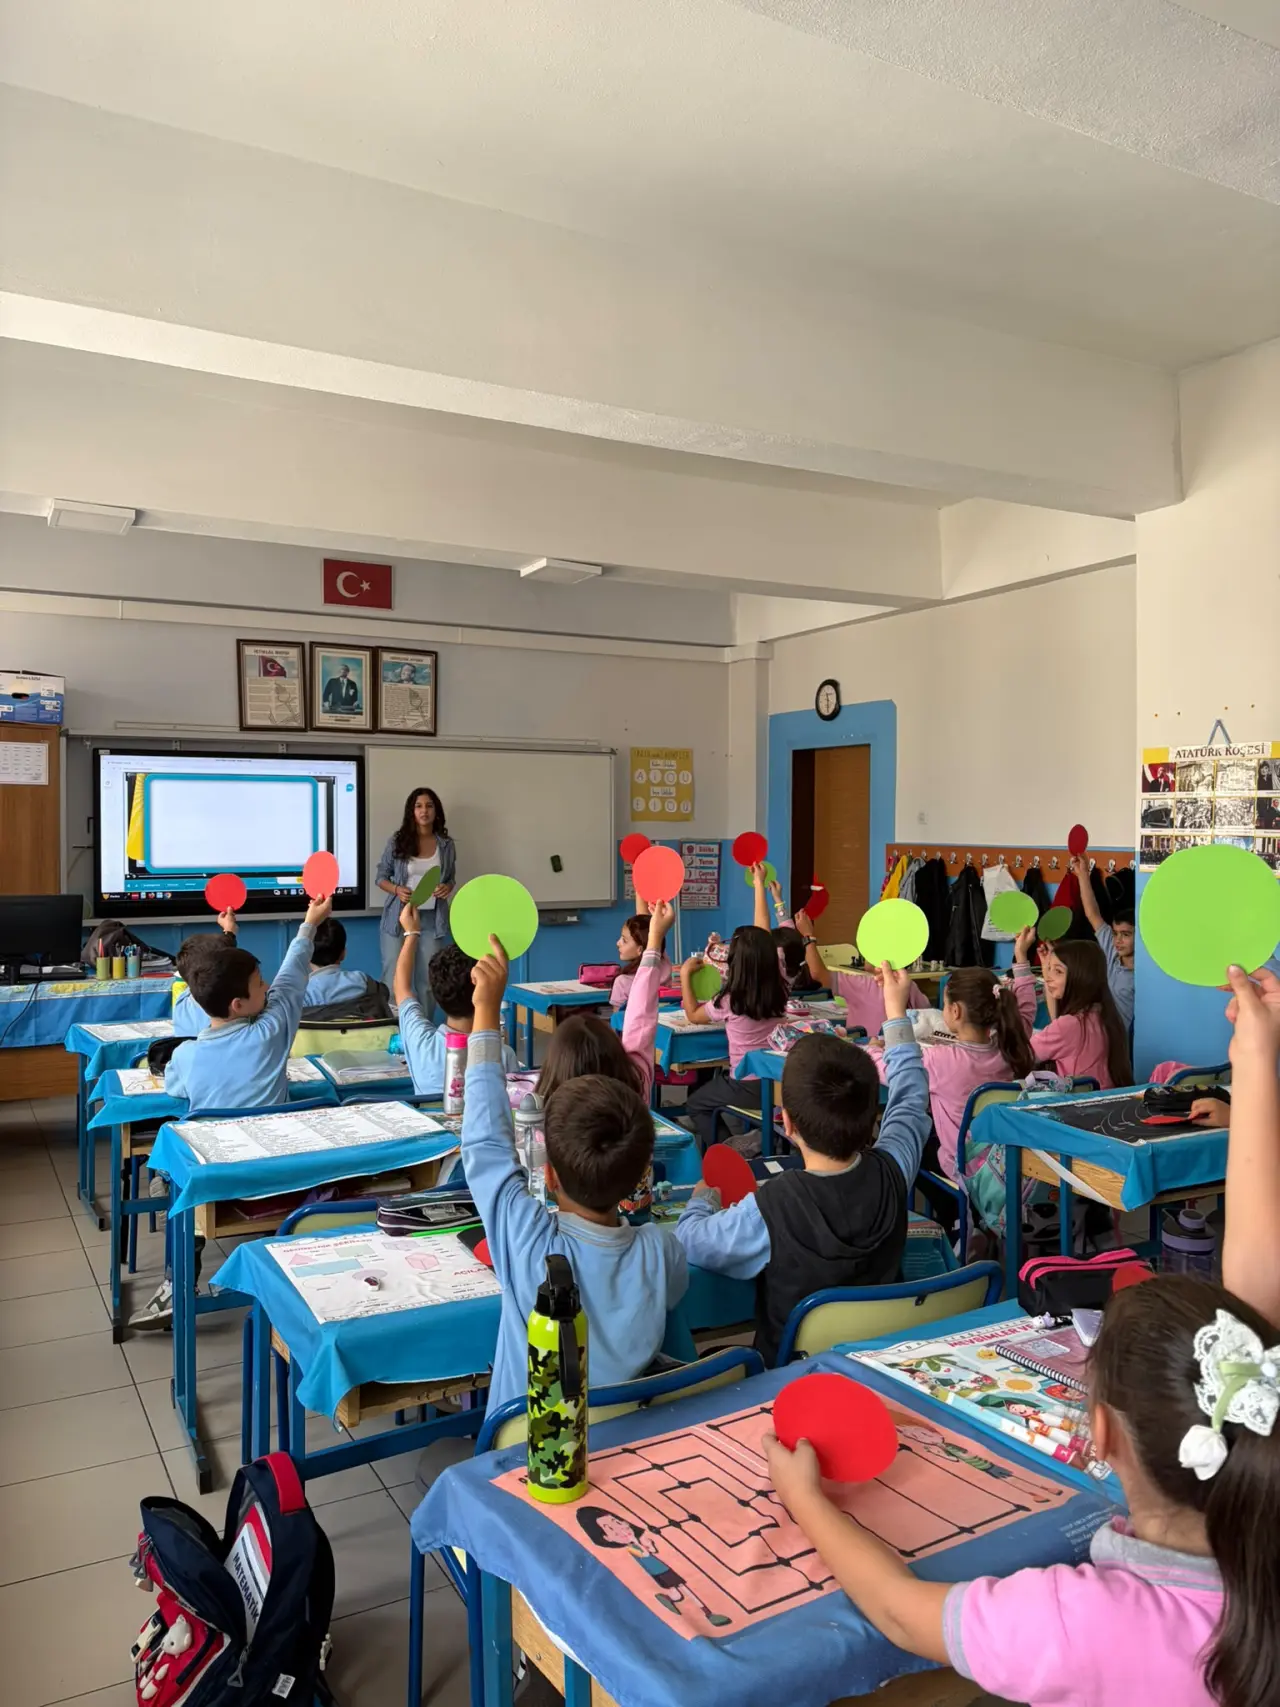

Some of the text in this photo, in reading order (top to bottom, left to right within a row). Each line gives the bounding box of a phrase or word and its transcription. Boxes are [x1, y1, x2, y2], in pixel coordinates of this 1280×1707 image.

[1175, 746, 1222, 759] ATATÜRK
[948, 1328, 1019, 1348] MEVSİMLER
[232, 1551, 260, 1624] MATEMATİK
